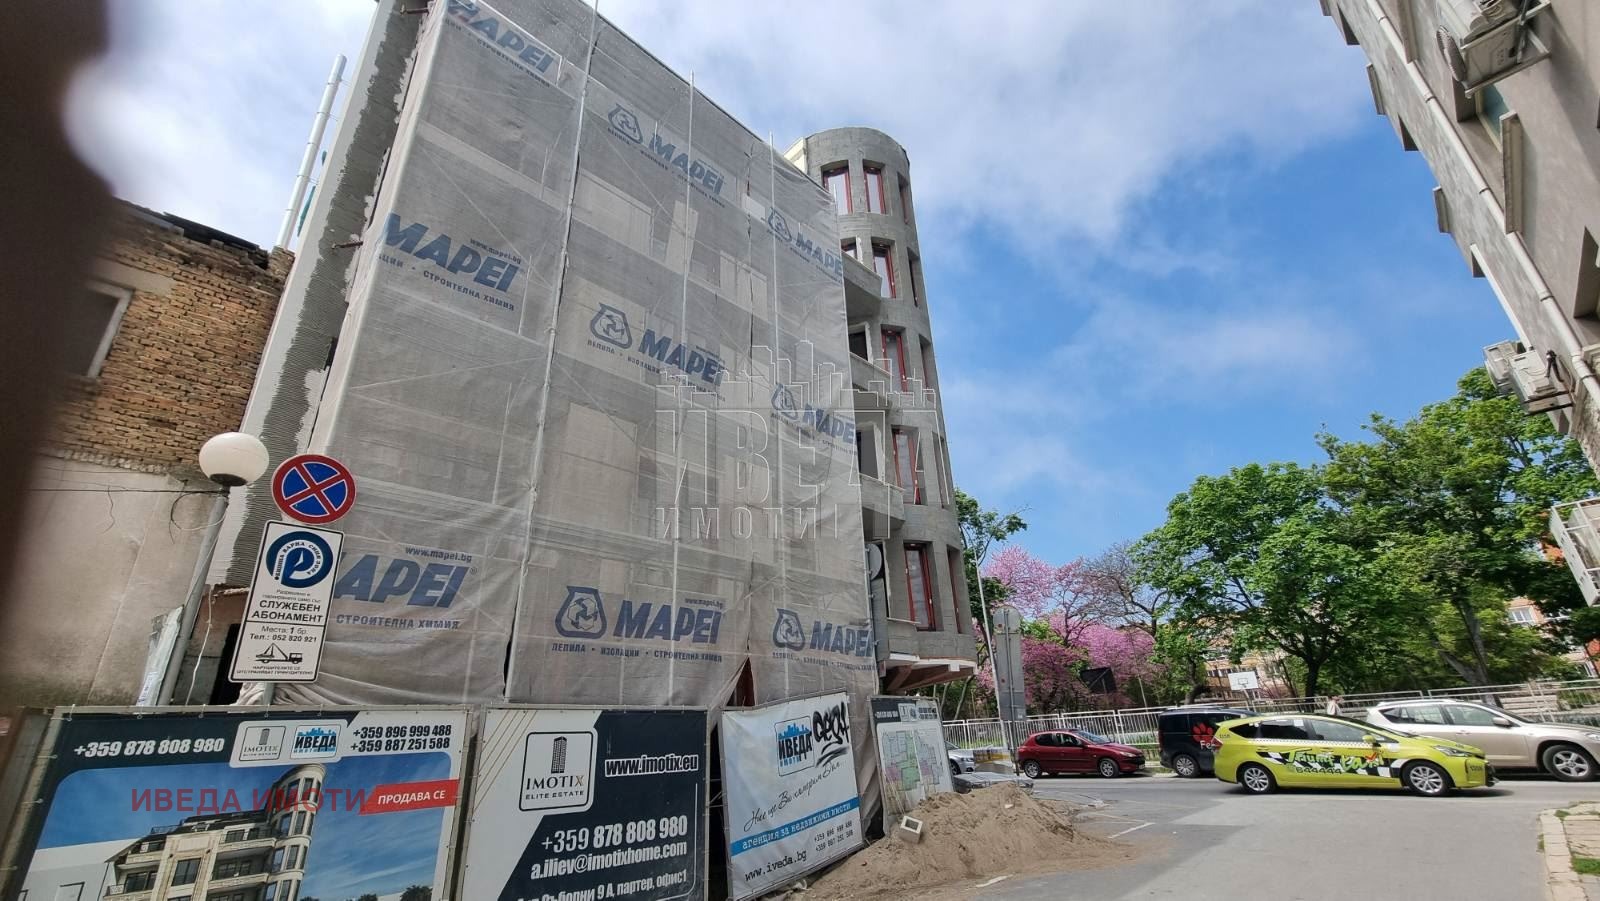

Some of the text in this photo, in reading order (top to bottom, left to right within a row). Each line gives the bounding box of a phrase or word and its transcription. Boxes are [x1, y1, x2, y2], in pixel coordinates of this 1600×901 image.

[648, 132, 724, 196] MAPEI
[423, 270, 481, 299] СТРОИТЕЛНА
[483, 294, 515, 312] ХИМИЯ
[405, 546, 473, 564] www.mapei.bg
[334, 552, 471, 608] APEI
[259, 600, 321, 613] СЛУЖЕБЕН
[252, 610, 324, 623] АБОНАМЕНТ
[336, 614, 461, 631] СТРОИТЕЛНА ХИМИЯ
[613, 600, 722, 644] MAPEI
[261, 625, 288, 634] Места:
[290, 626, 295, 634] 1
[552, 642, 586, 654] ЛЕПИЛА
[601, 647, 640, 659] ИЗОЛАЦИИ
[353, 724, 452, 739] +359 896 999 488
[74, 737, 225, 758] +359 878 808 980
[294, 735, 337, 752] ИВЕДА
[351, 737, 450, 752] +359 887 251 588
[778, 731, 813, 761] ИВЕДА
[604, 754, 699, 777] www.imotix.eu
[526, 775, 585, 790] IMOTIX
[378, 790, 446, 805] ПРОДАВА СЕ
[552, 790, 585, 798] ESTATE
[541, 815, 688, 853] +359 878 808 980
[742, 832, 781, 849] агенция
[530, 841, 688, 880] a.iliev@imotixhome.com
[745, 850, 807, 882] www.iveda.bg
[597, 884, 606, 899] 9
[617, 874, 655, 895] партер,
[656, 869, 688, 888] офис1
